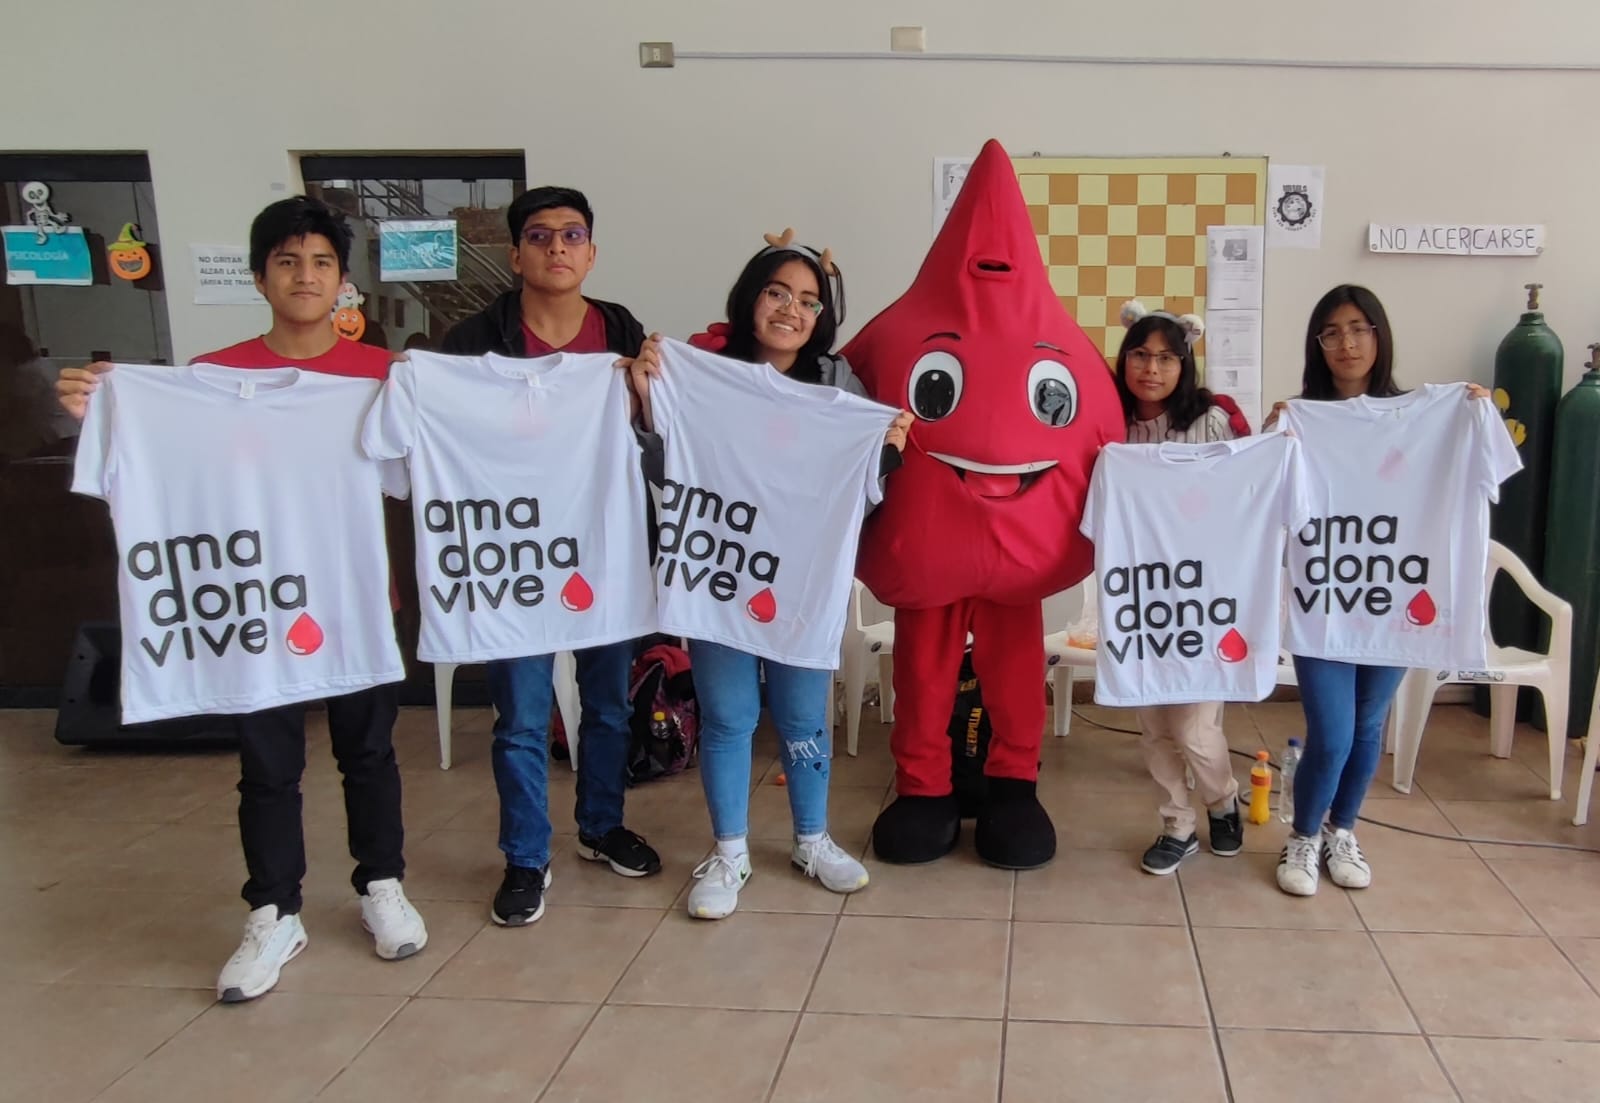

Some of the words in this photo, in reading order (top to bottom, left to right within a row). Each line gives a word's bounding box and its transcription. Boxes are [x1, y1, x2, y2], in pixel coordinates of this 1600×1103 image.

[1379, 228, 1407, 250] NO
[1417, 227, 1538, 250] ACERCARSE
[424, 497, 540, 533] ama
[127, 530, 262, 581] ama
[438, 537, 579, 578] dona
[659, 521, 780, 584] dona
[1305, 554, 1429, 586] dona
[430, 574, 544, 614] vive
[1104, 560, 1202, 597] ama
[149, 574, 307, 627] dona
[1115, 597, 1237, 633] dona
[1294, 586, 1393, 616] vive
[140, 618, 268, 668] vive
[1106, 630, 1203, 665] vive
